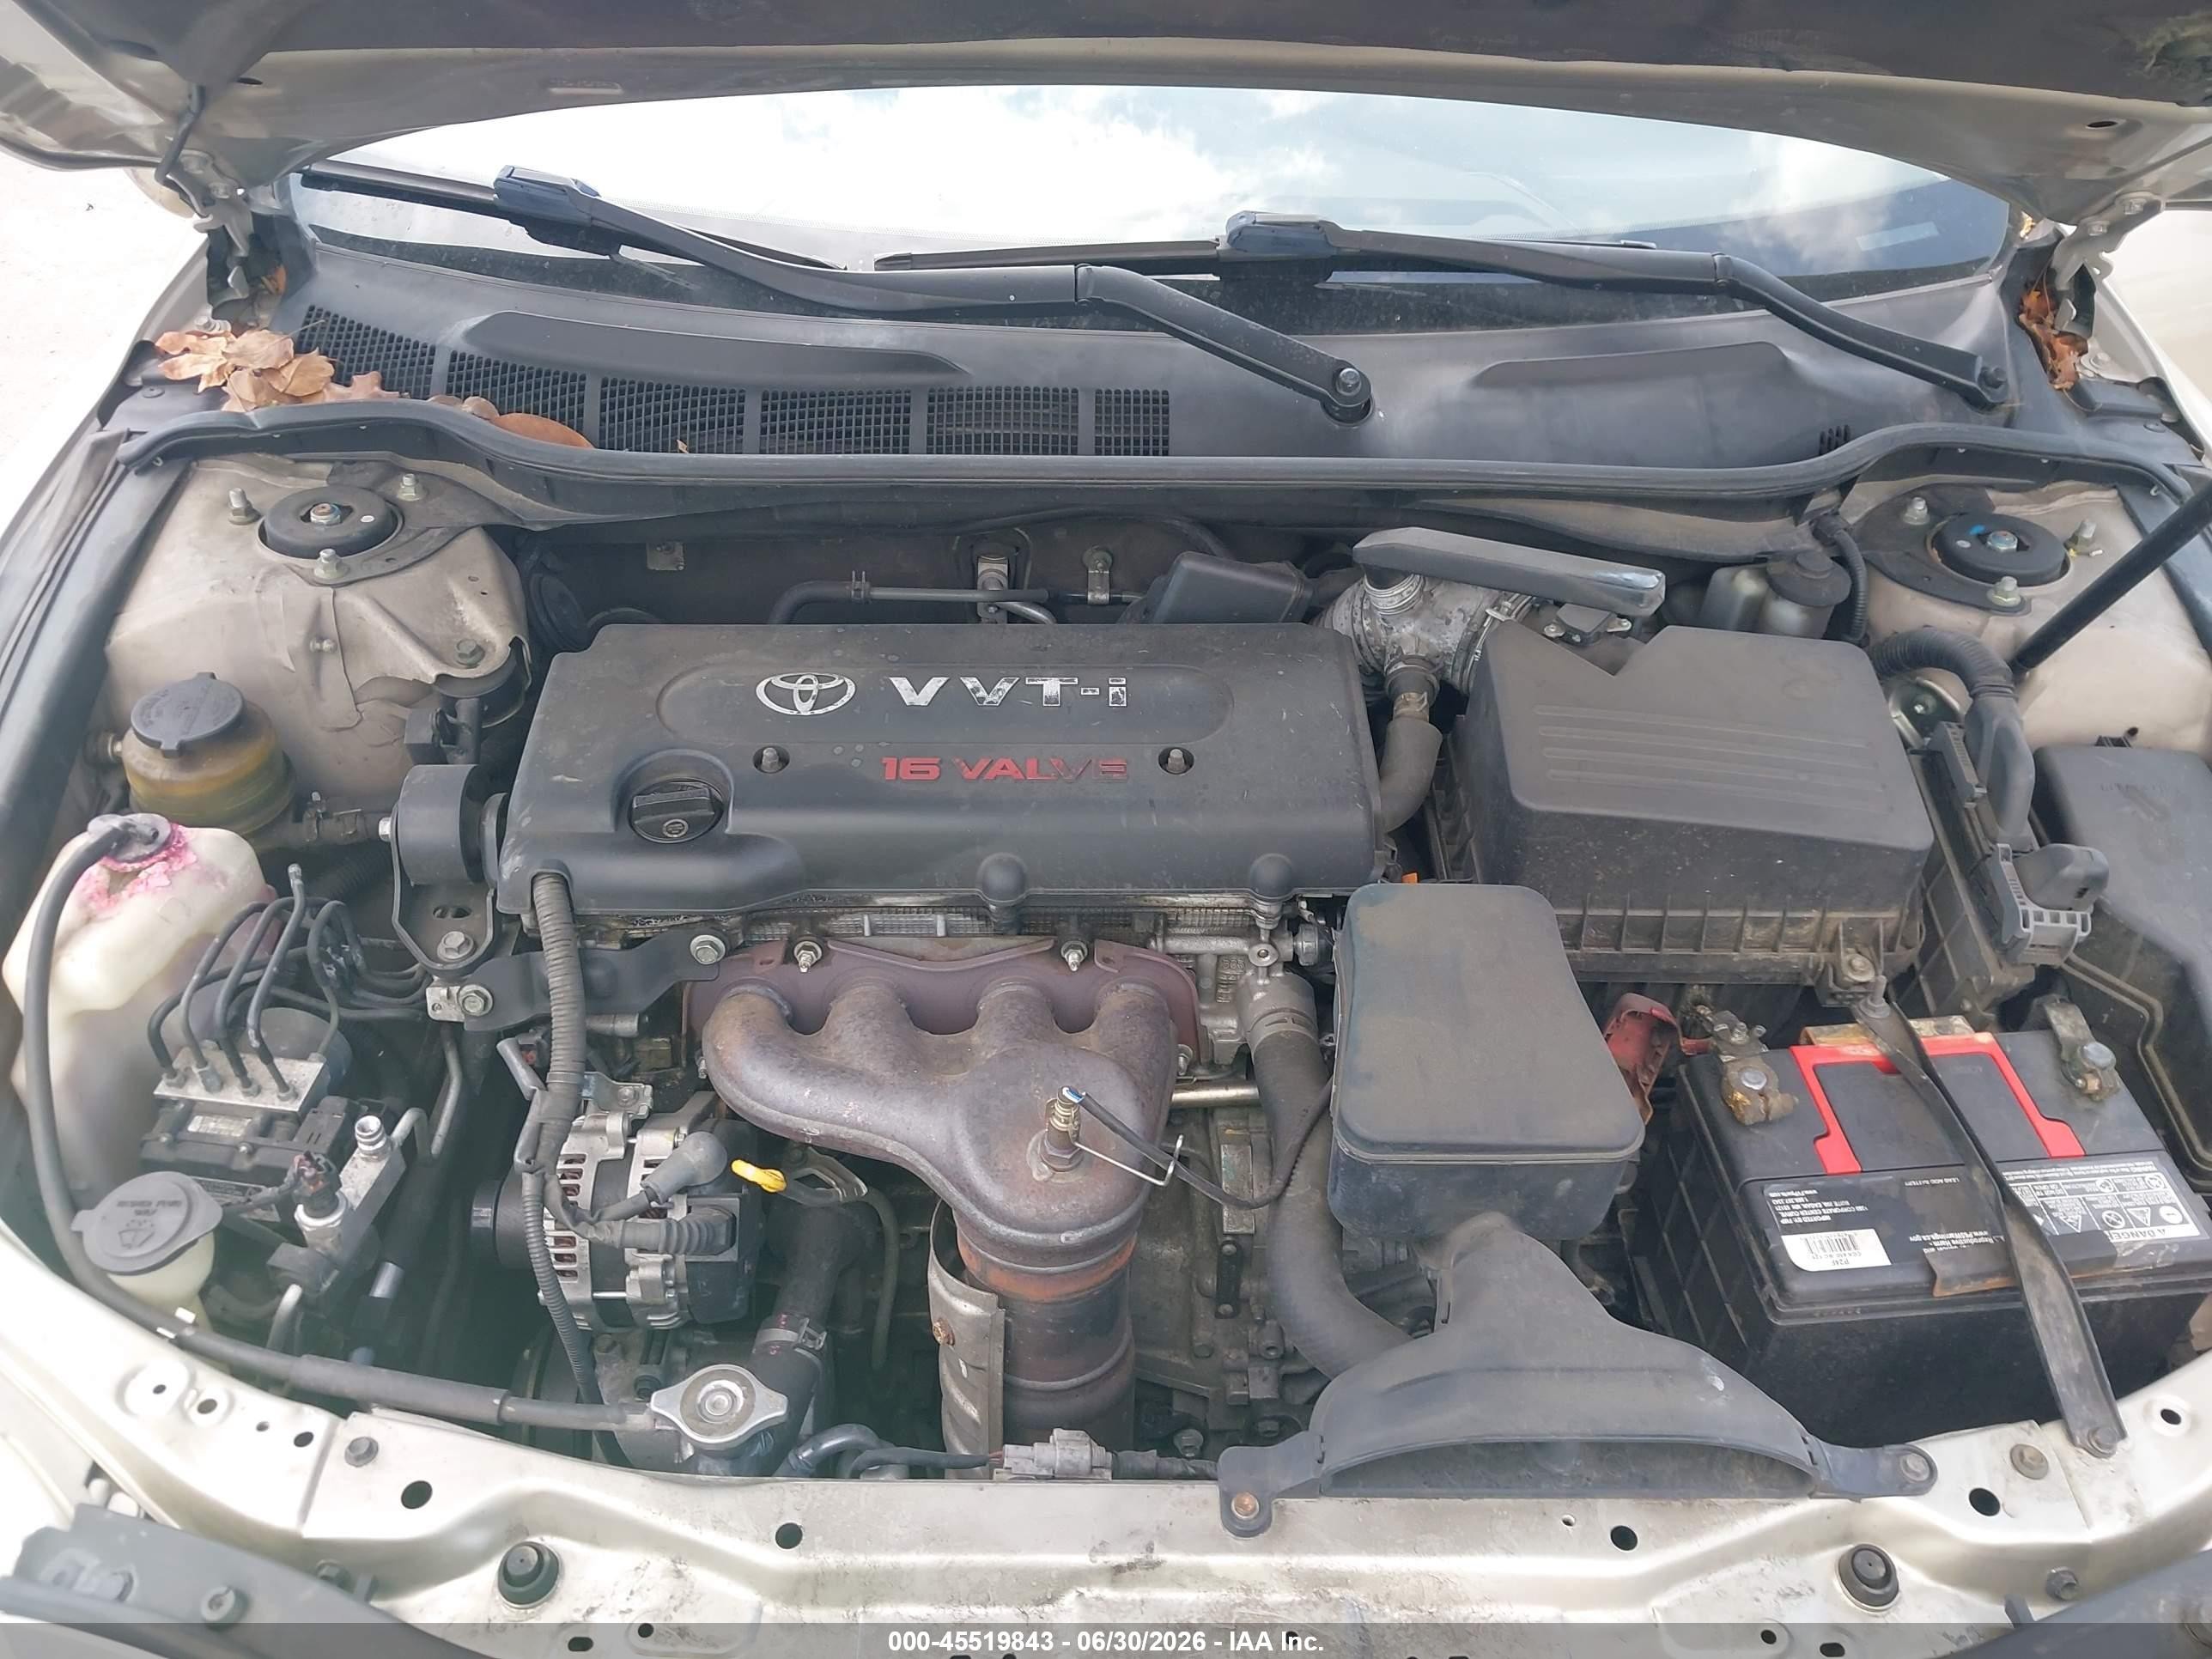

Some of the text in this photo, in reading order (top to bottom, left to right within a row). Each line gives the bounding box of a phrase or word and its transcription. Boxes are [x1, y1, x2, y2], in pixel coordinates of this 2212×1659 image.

[889, 677, 1127, 707] VVT-i
[880, 756, 1128, 781] 16 VALVE
[1951, 1237, 1994, 1246] Reproductive
[2108, 1230, 2156, 1240] DANGE
